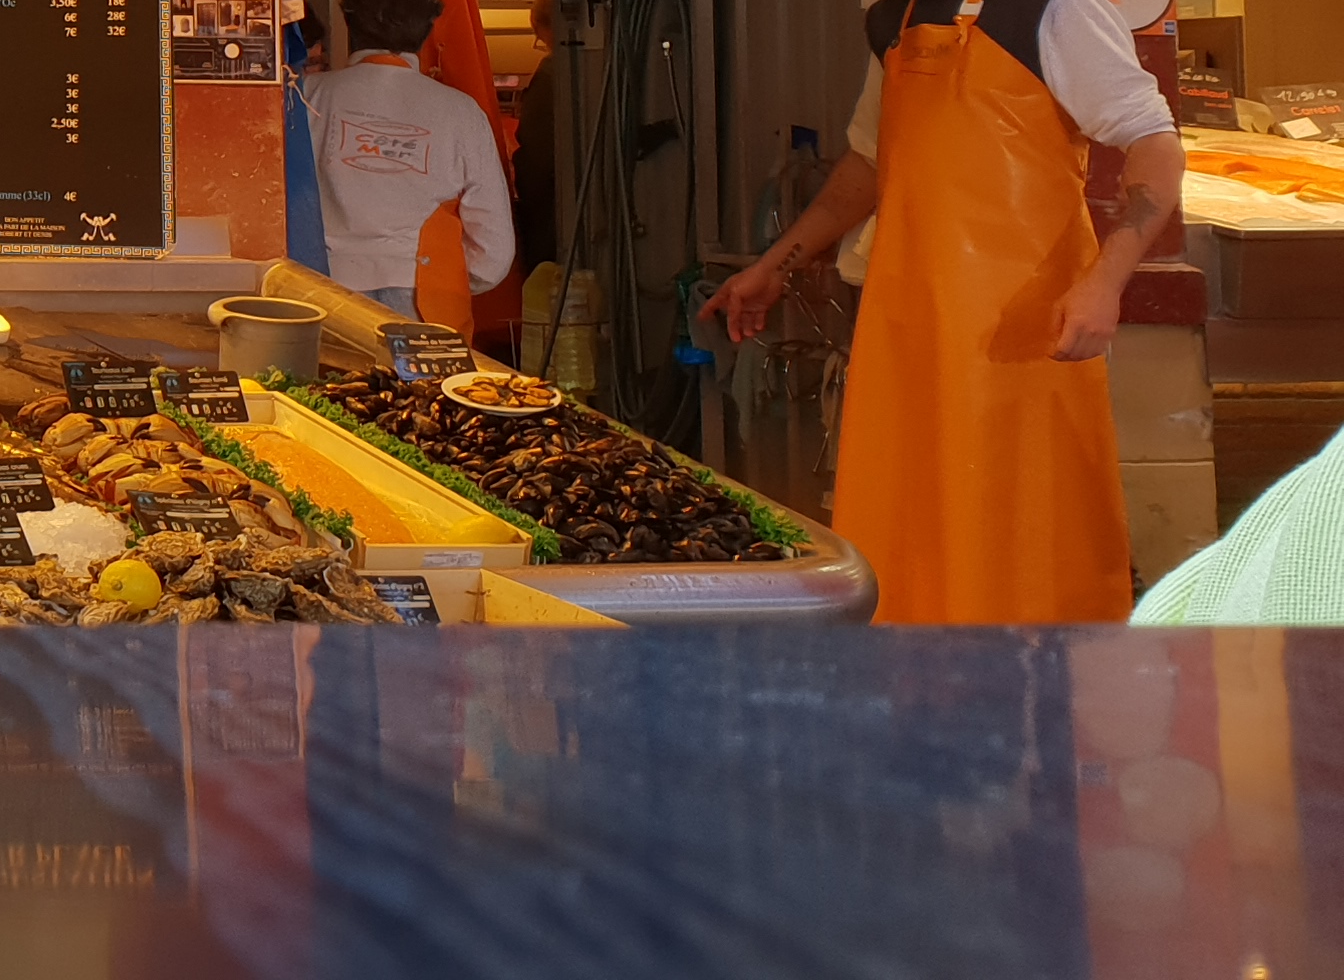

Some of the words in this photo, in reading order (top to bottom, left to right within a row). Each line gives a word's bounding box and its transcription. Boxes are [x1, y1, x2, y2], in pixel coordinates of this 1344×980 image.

[65, 13, 77, 22] 6€
[107, 11, 125, 20] 28€
[65, 28, 77, 36] 7€
[107, 26, 125, 35] 32€
[67, 74, 79, 83] 3€
[66, 89, 78, 98] 3€
[66, 104, 78, 113] 3€
[51, 118, 78, 129] 2,50€
[66, 134, 78, 143] 3€
[355, 133, 417, 149] Côté
[357, 144, 412, 159] Mer
[23, 191, 50, 201] (33cl)
[64, 192, 76, 201] 4€
